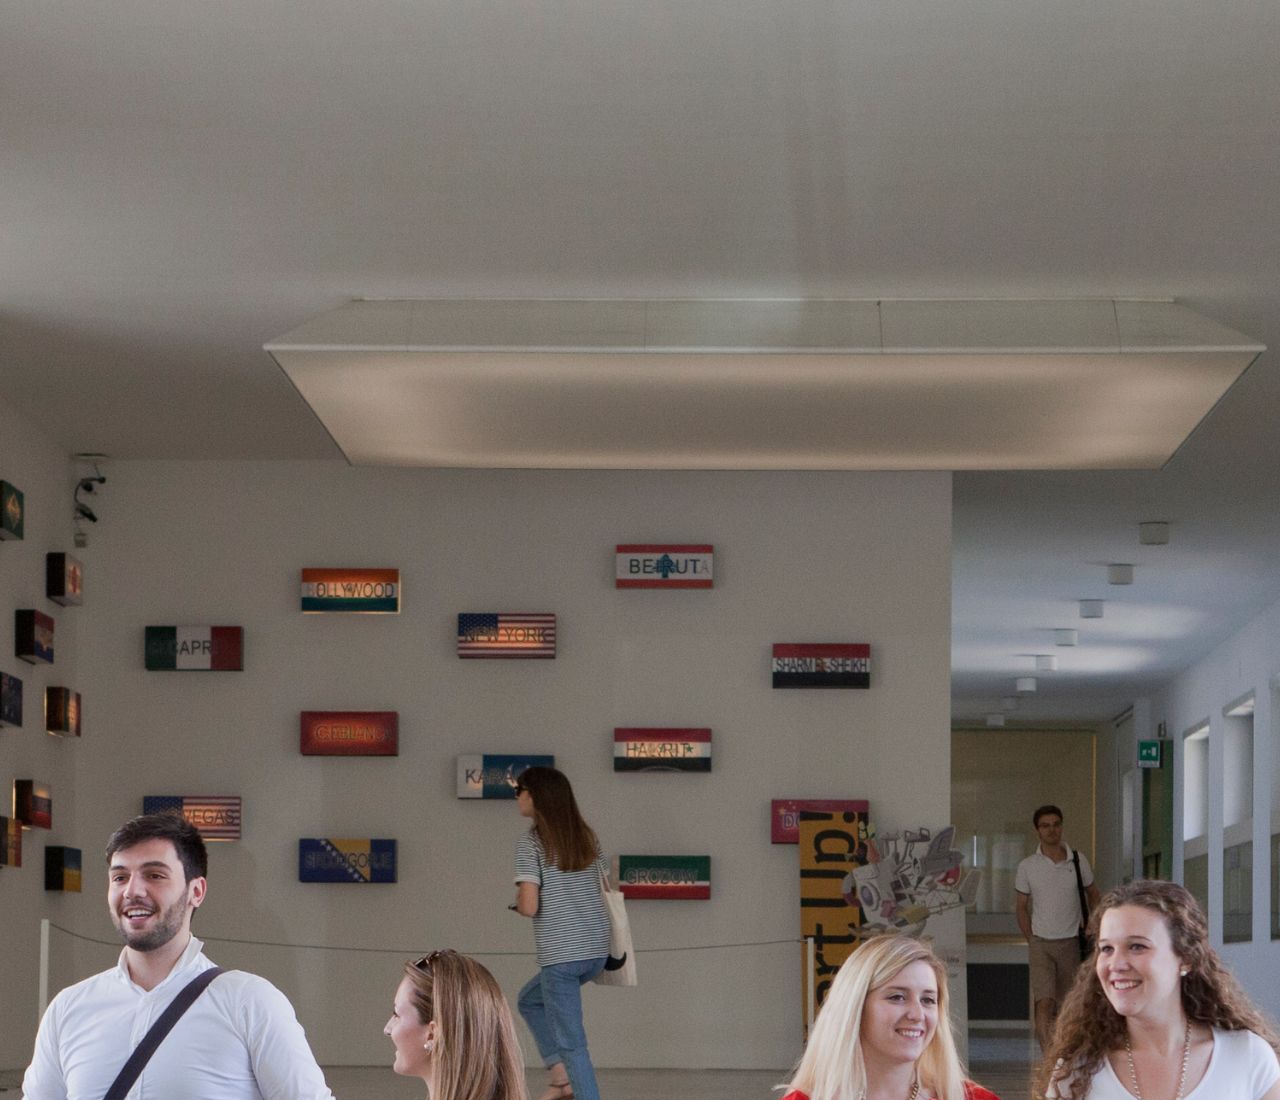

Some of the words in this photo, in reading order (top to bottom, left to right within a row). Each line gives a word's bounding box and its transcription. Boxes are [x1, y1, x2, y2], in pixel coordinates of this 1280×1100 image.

[629, 558, 700, 574] BEIRUT
[464, 627, 498, 643] NEW
[504, 627, 545, 643] YORK
[776, 657, 813, 673] SHARM
[830, 657, 867, 673] SHEIKH
